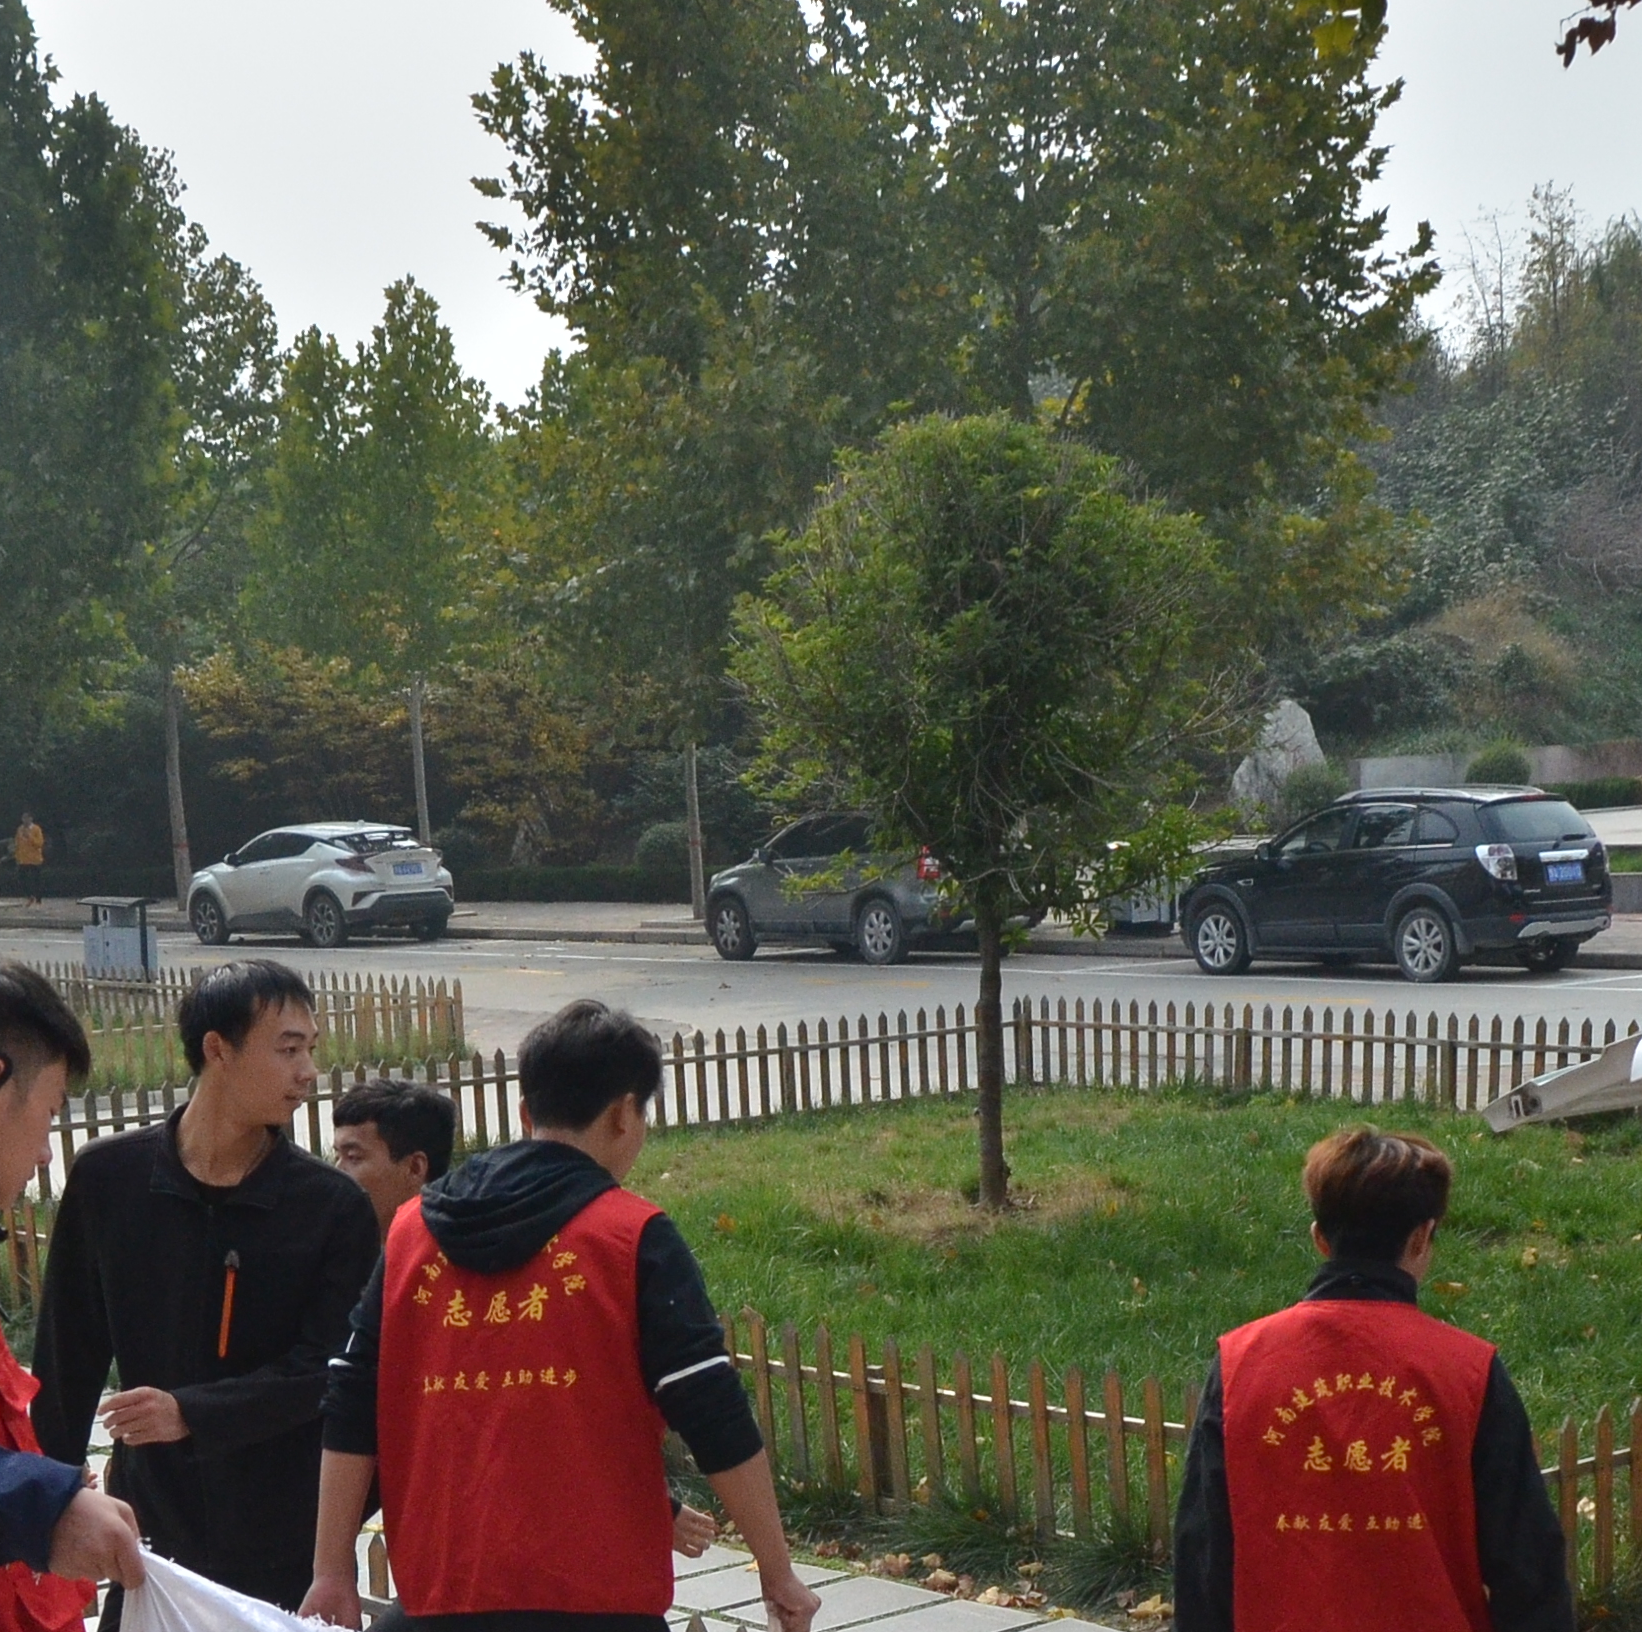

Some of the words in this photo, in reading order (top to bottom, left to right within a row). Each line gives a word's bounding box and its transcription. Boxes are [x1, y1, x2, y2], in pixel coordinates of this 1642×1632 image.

[442, 1283, 550, 1328] 志愿者
[1304, 1436, 1412, 1472] 志愿者
